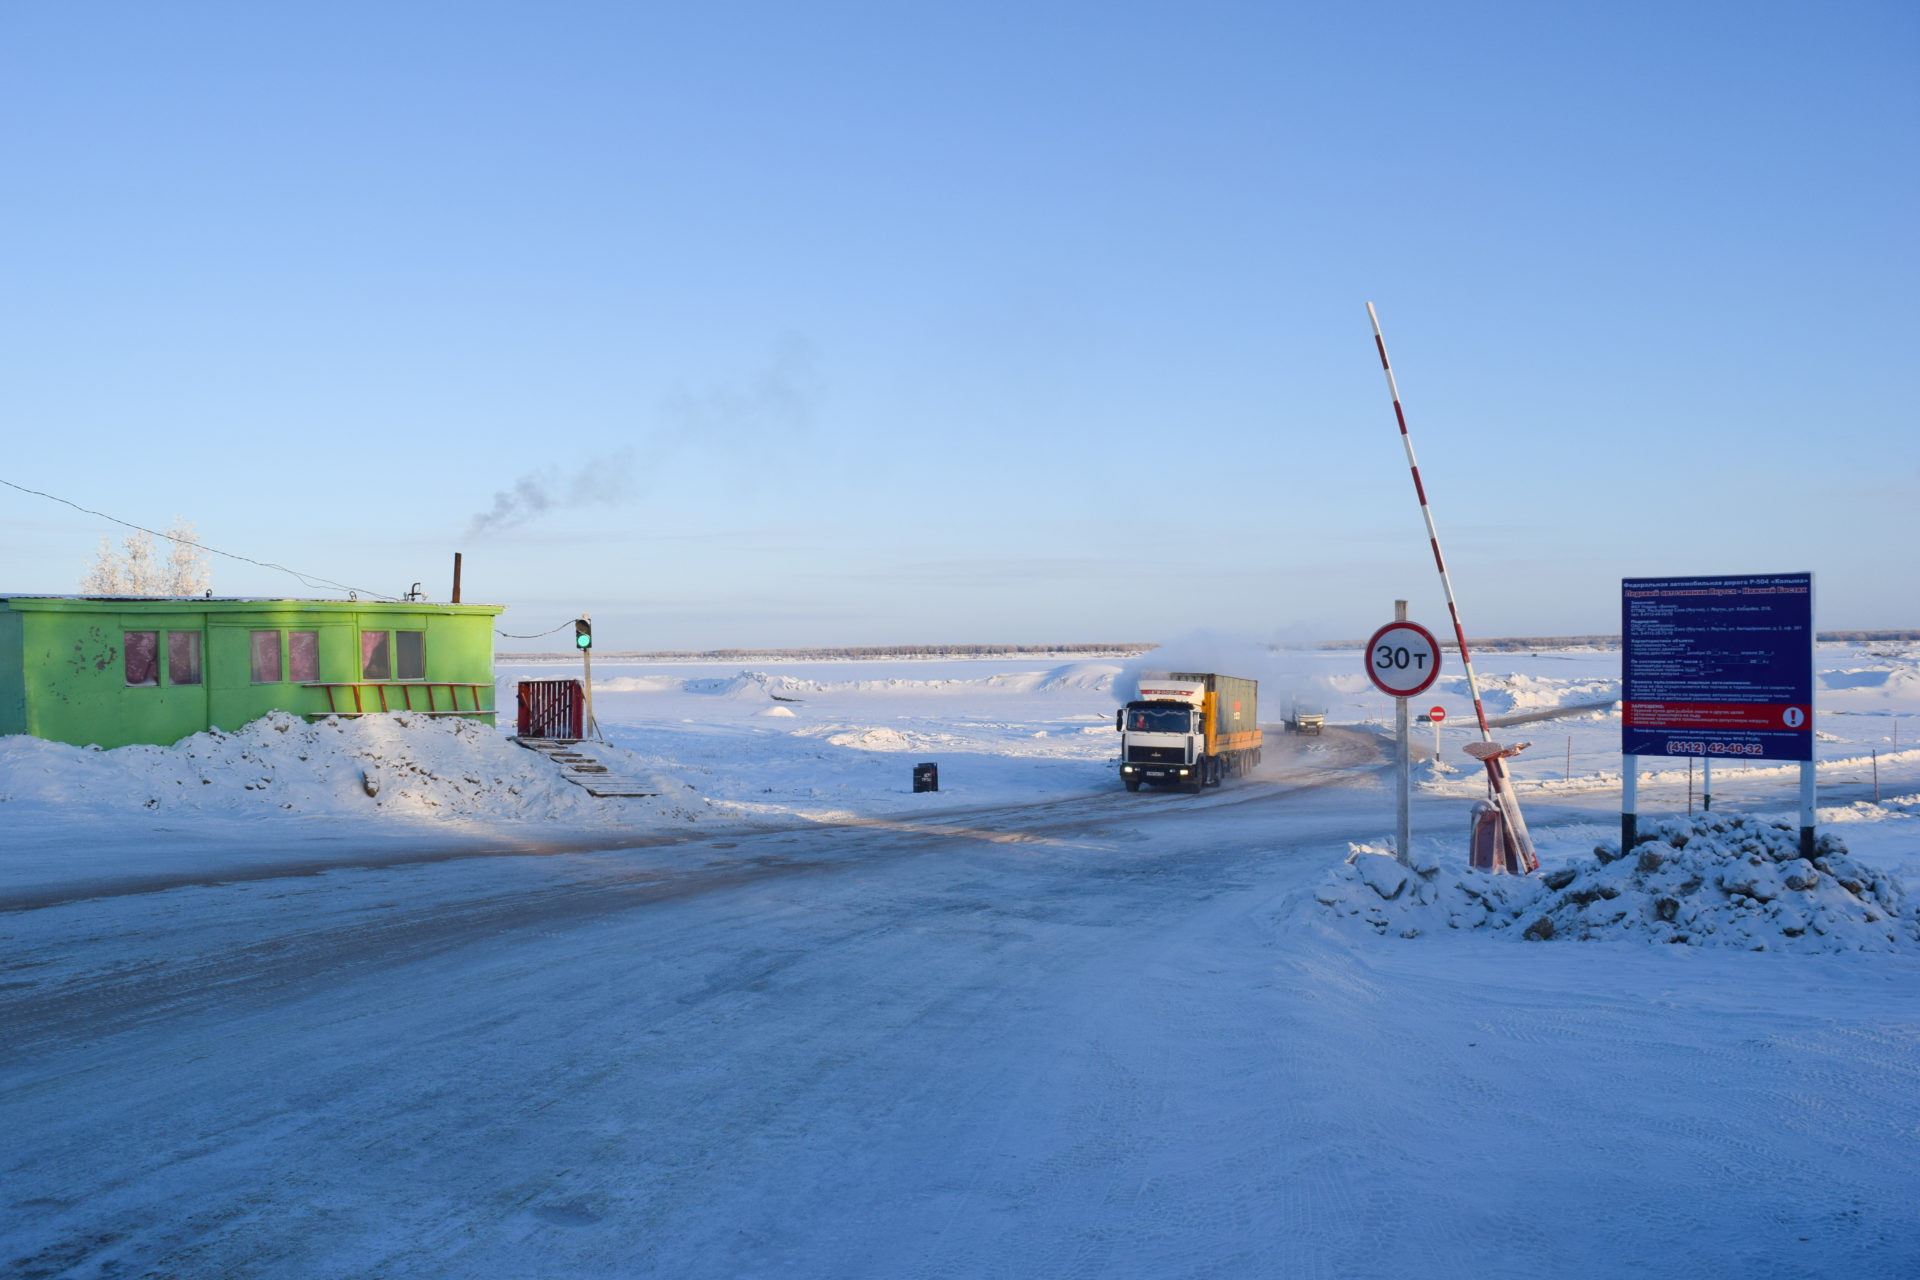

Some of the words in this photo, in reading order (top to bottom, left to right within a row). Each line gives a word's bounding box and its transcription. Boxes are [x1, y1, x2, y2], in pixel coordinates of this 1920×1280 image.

[1376, 645, 1410, 669] 30
[1667, 741, 1706, 755] (4112)
[1708, 742, 1763, 755] 42-40-32
